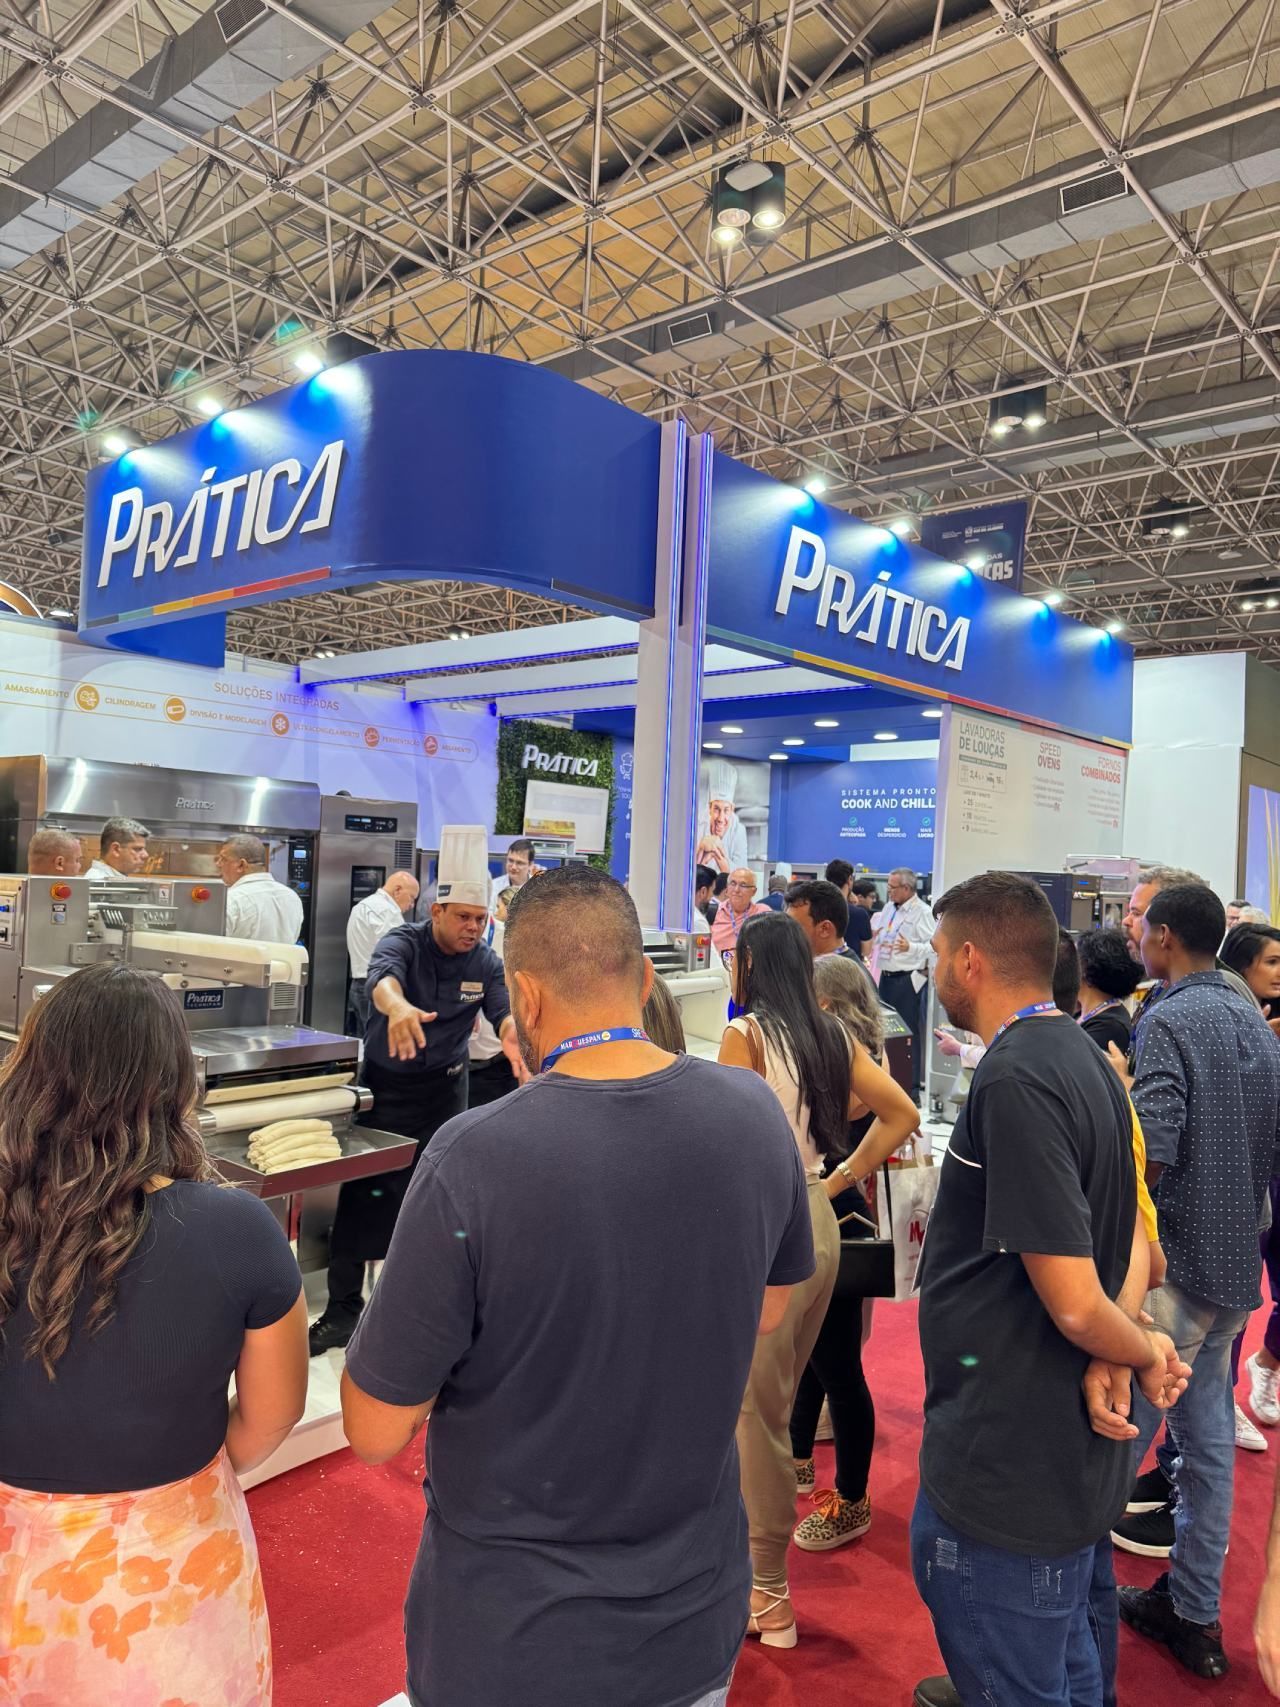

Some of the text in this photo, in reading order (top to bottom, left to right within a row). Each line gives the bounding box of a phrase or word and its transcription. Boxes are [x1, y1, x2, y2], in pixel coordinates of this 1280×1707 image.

[97, 439, 344, 588] PRÁTICA
[775, 525, 971, 671] PRÁTICA
[4, 683, 70, 699] AMASSAMENTO
[214, 682, 340, 711] SOLUÇÕES INTEGRADAS
[104, 697, 156, 710] CILINDRAGEM
[960, 720, 1005, 744] LAVADORAS
[959, 736, 1005, 759] DE LOUÇAS
[1040, 742, 1062, 757] SPEED
[521, 744, 599, 777] PRÁTICA
[1038, 754, 1061, 770] OVENS
[1081, 765, 1121, 784] COMBINADOS
[893, 787, 937, 795] PRONTO
[841, 798, 936, 809] COOK AND CHILL
